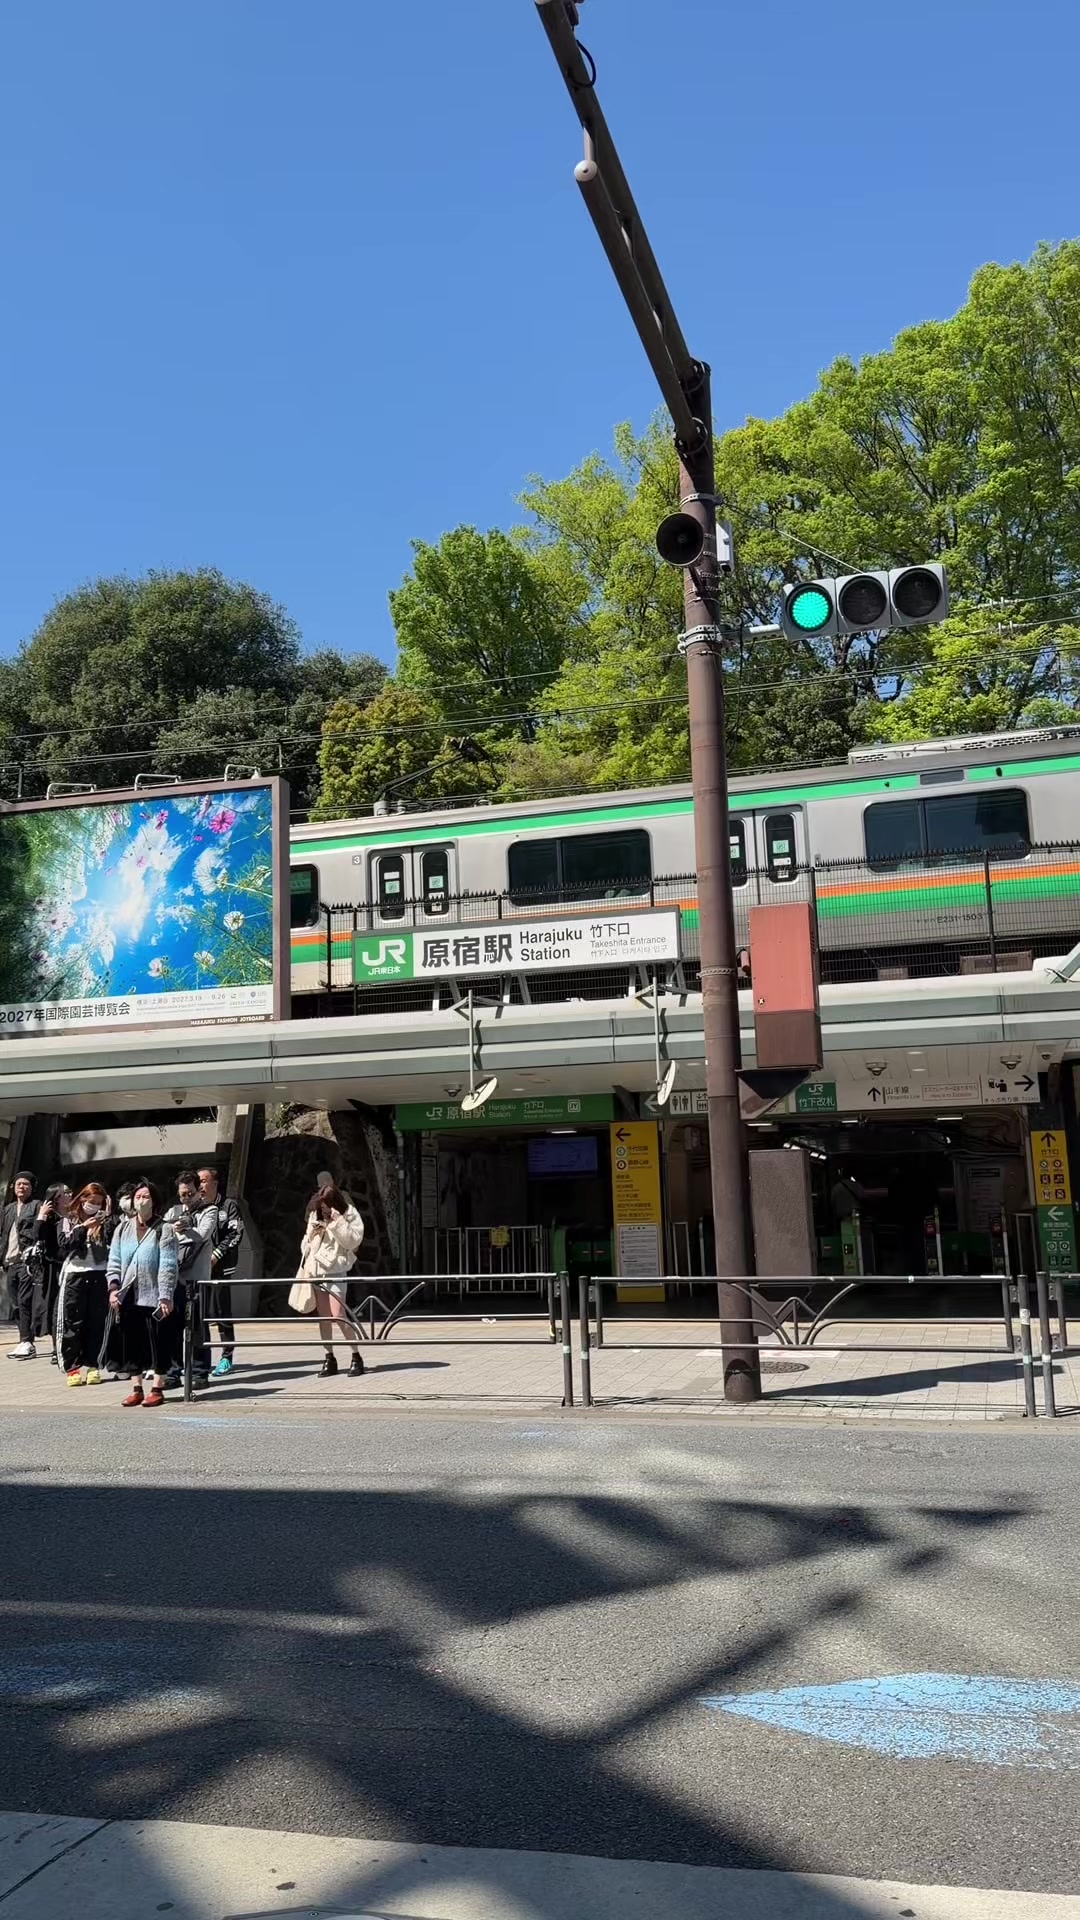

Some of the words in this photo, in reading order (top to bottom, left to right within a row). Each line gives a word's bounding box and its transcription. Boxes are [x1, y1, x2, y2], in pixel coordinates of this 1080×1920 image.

[519, 927, 583, 945] Harajuku
[590, 922, 630, 938] 竹下口
[590, 938, 628, 948] Takeshita
[630, 936, 666, 945] Entrance
[362, 939, 406, 967] JR
[421, 933, 513, 969] 原宿駅
[519, 946, 571, 962] Station
[368, 966, 401, 976] JR東日本
[0, 1001, 130, 1024] 2027年国際園芸博覧会
[808, 1084, 824, 1093] JR
[798, 1095, 836, 1108] 竹下改札
[426, 1107, 443, 1117] JR
